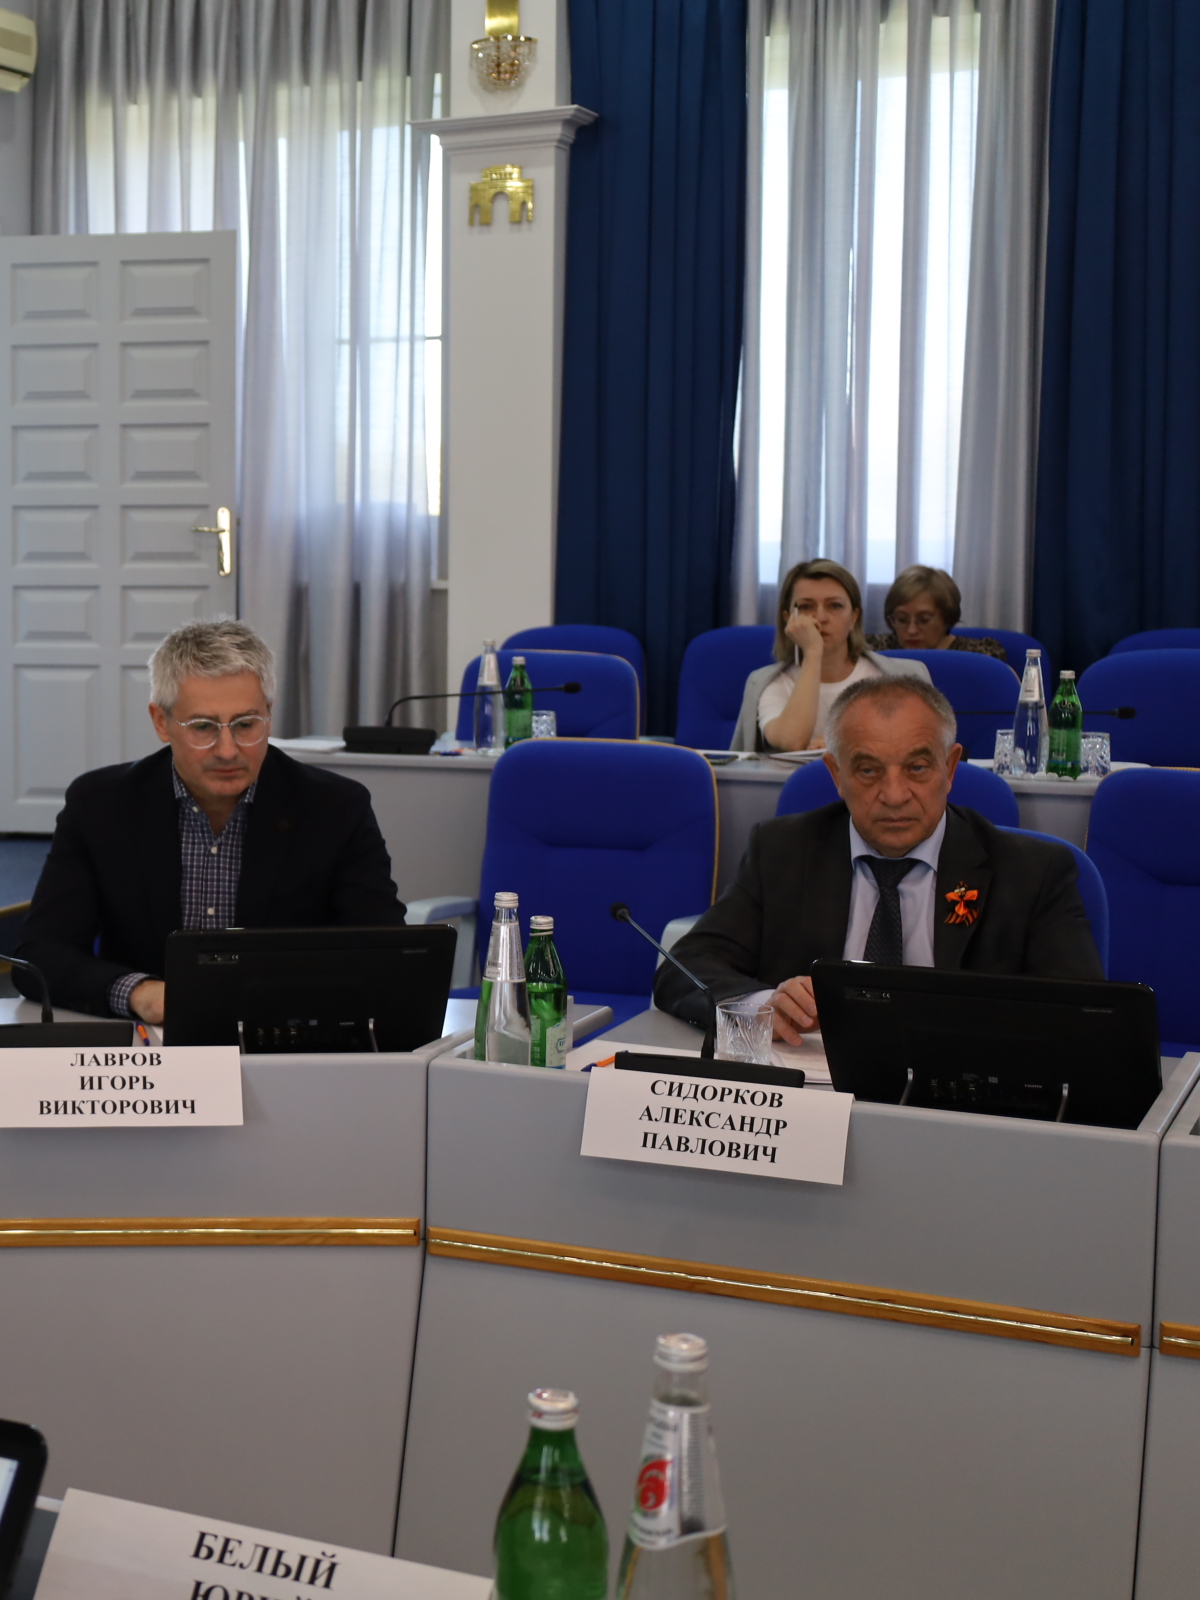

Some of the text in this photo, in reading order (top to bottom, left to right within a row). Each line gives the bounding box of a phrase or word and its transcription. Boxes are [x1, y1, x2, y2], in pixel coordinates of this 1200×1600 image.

[70, 1052, 162, 1067] ЛАВРОВ
[79, 1075, 155, 1091] ИГОРЬ
[650, 1079, 784, 1108] СИДОРКОВ
[38, 1099, 197, 1115] ВИКТОРОВИЧ
[638, 1105, 788, 1139] АЛЕКСАНДР
[640, 1131, 779, 1164] ПАВЛОВИЧ
[190, 1530, 340, 1590] БЕЛЫЙ
